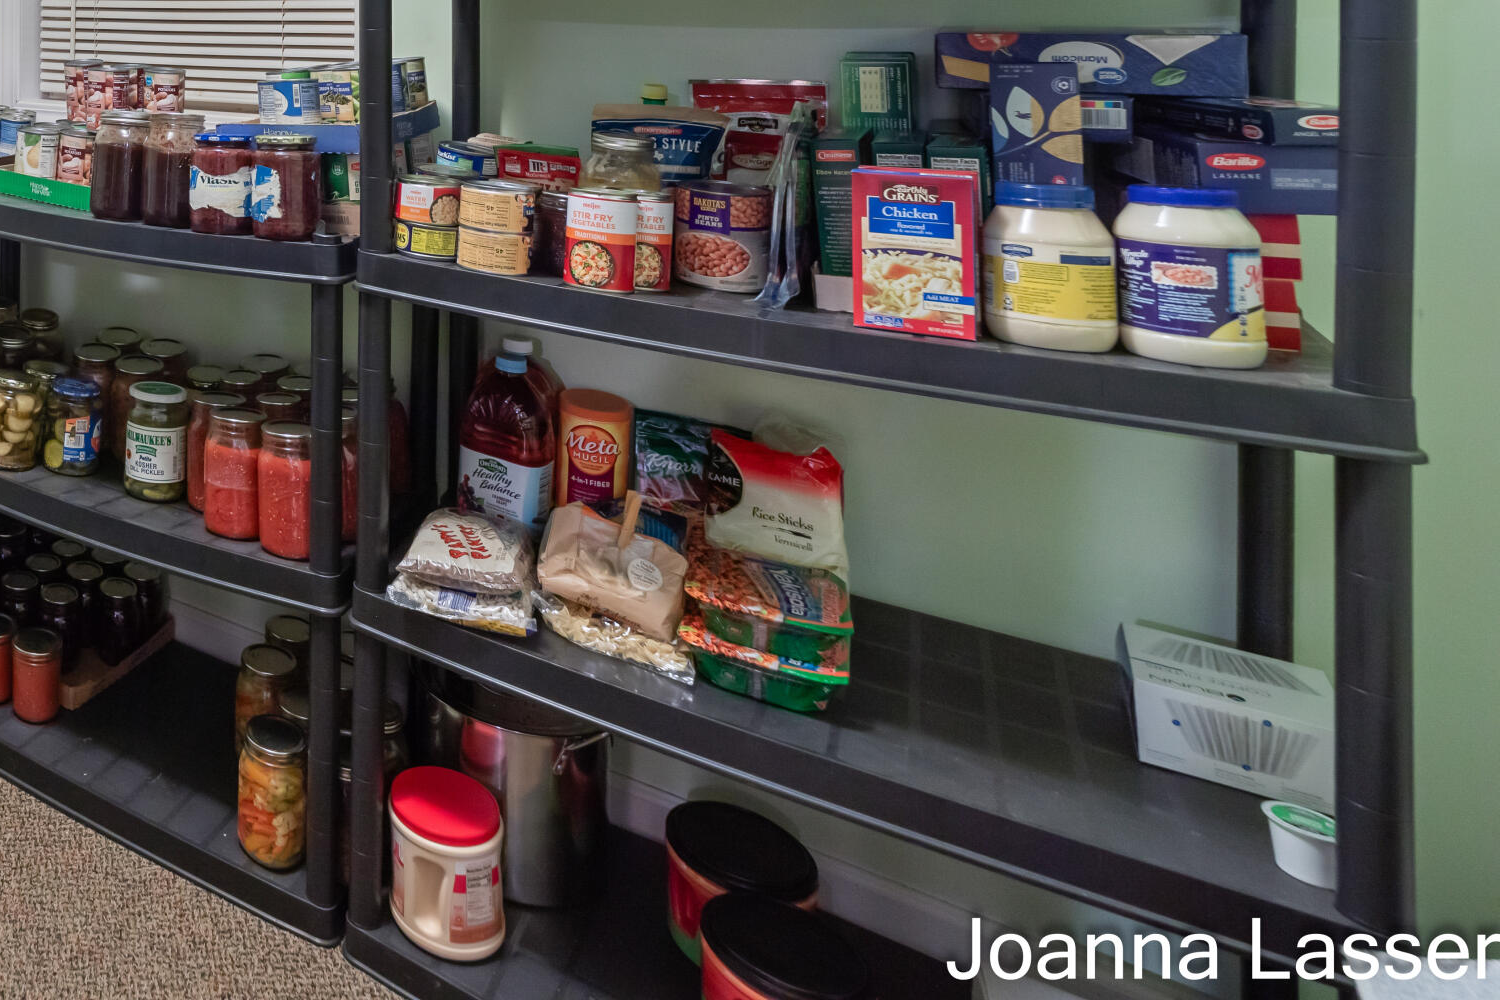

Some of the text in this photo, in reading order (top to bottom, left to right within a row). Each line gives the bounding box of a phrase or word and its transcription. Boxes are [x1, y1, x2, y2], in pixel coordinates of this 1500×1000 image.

[1051, 54, 1107, 64] Manicotti
[662, 138, 702, 154] STYLE
[1212, 156, 1259, 168] Barilla
[884, 189, 935, 203] GRAINS
[896, 185, 928, 196] earthly
[693, 197, 726, 209] DAKOTA'S
[573, 211, 614, 223] STIR FRY
[697, 214, 720, 222] PINTO
[882, 206, 938, 221] Chicken
[571, 219, 616, 230] VEGETABLES
[646, 216, 665, 224] FRY
[695, 219, 723, 228] BEANS
[574, 231, 607, 241] TRADITIONAL
[567, 431, 620, 455] Meta
[573, 451, 609, 464] MUCIL
[135, 461, 157, 469] KOSHER
[644, 453, 702, 475] Knorr
[472, 467, 512, 487] Healthy
[571, 475, 610, 488] 4-in-1 FIBER
[479, 479, 521, 500] Balance
[752, 506, 814, 531] Rice Sticks
